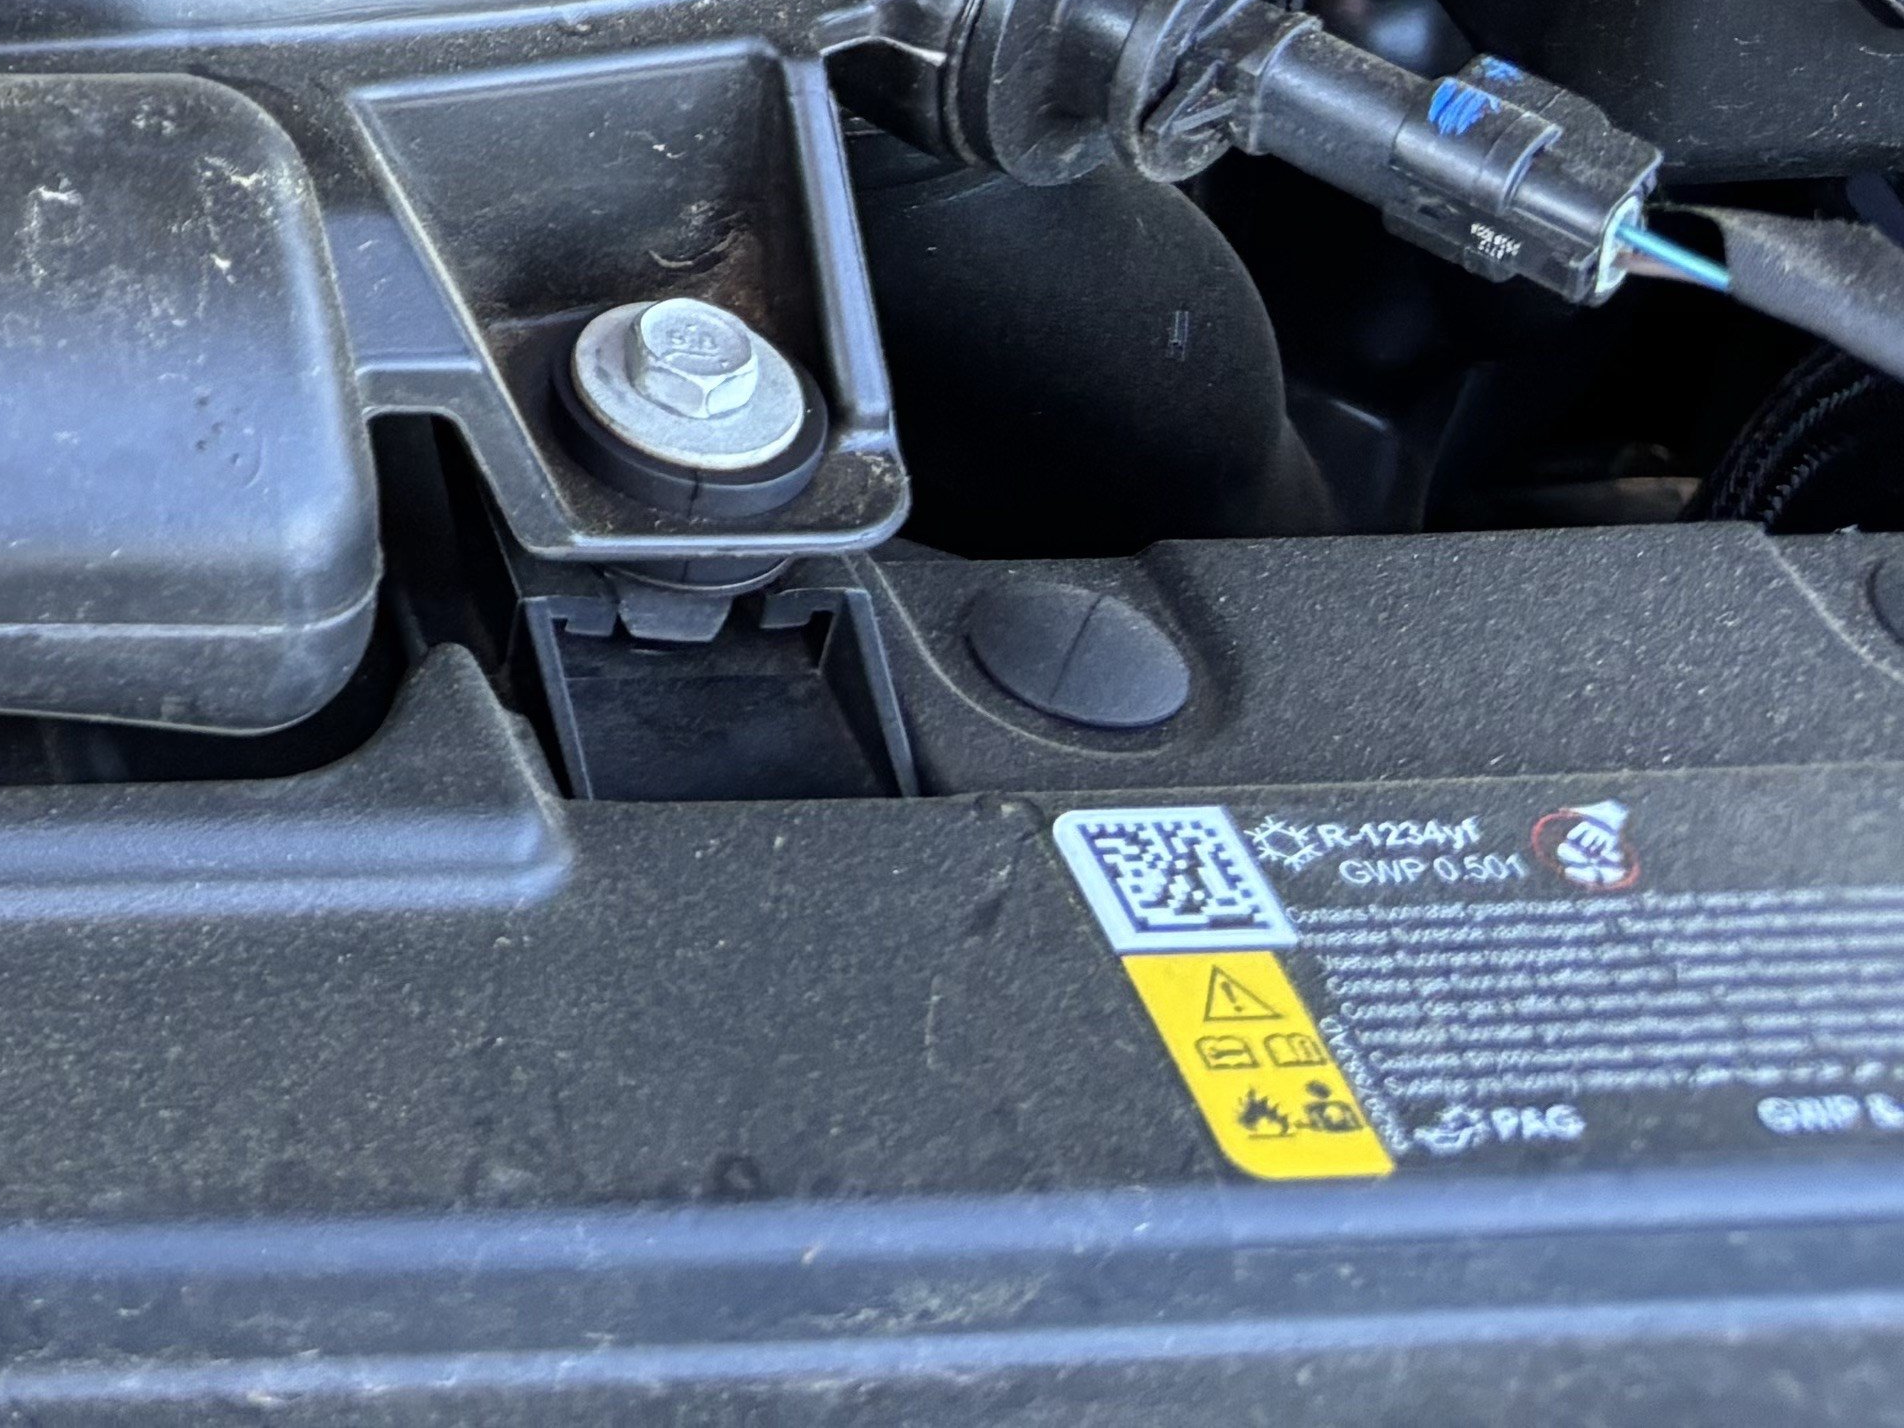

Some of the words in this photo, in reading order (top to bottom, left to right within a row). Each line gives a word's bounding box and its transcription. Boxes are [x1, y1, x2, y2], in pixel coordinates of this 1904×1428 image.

[1317, 814, 1481, 851] R-1234yf
[1339, 855, 1428, 886] GWP
[1433, 852, 1529, 882] 0.501
